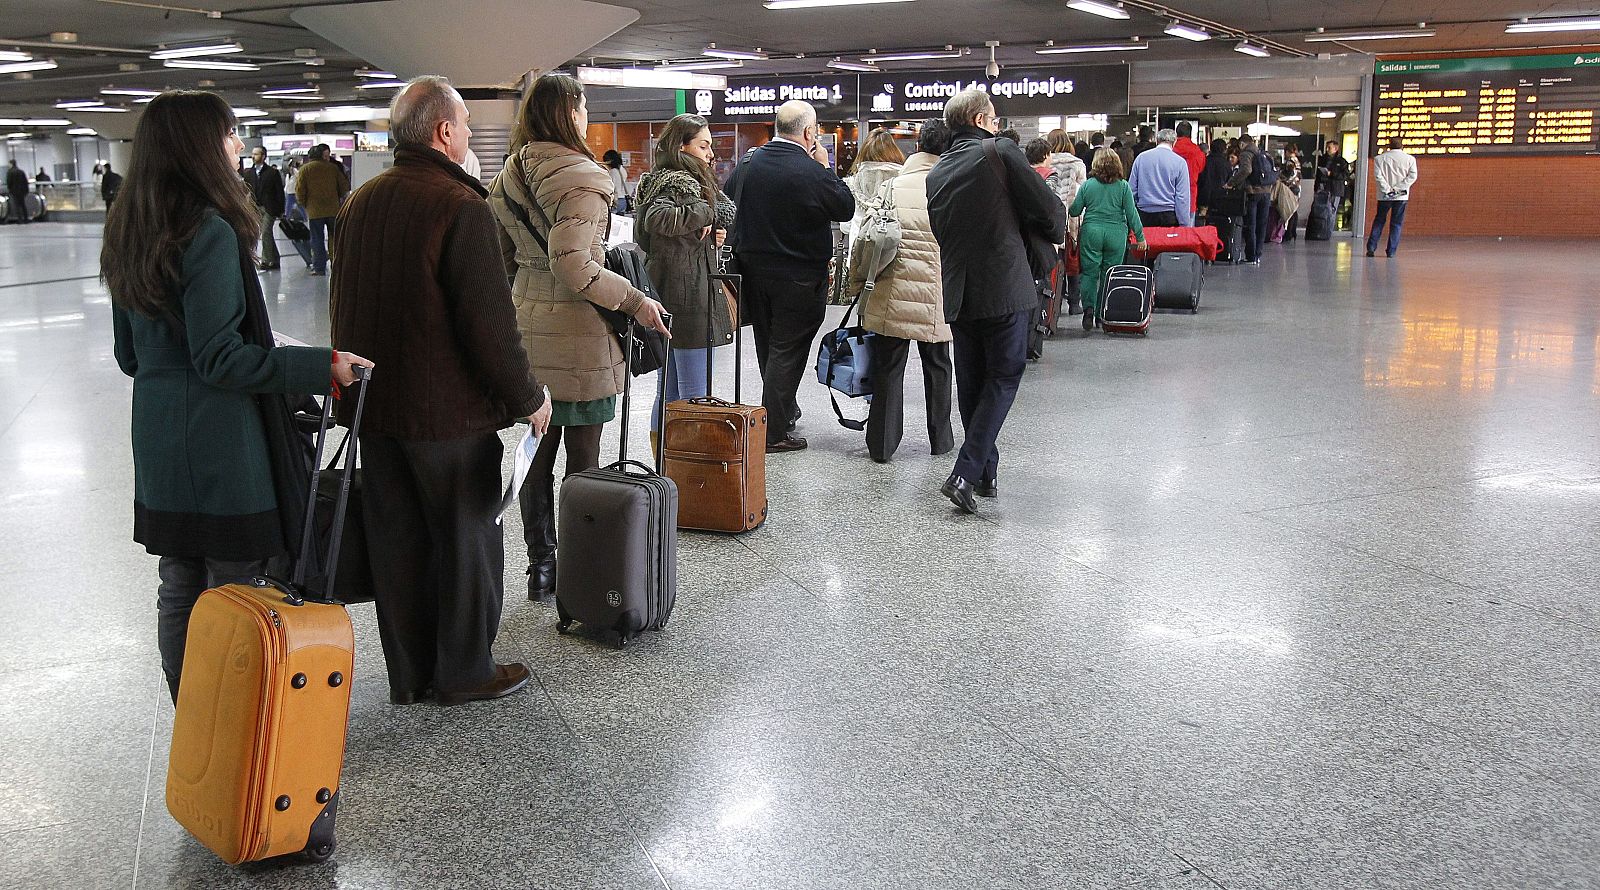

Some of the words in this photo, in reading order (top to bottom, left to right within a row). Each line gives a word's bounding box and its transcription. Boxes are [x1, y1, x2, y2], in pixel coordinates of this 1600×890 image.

[1381, 64, 1407, 72] Salidas
[904, 80, 961, 98] Control
[965, 80, 987, 92] de
[991, 77, 1073, 98] equipajes
[724, 85, 776, 103] Salidas
[779, 84, 828, 100] Planta
[832, 84, 842, 99] 1
[724, 105, 774, 115] DEPARTURES
[904, 101, 944, 111] LUGGAGE
